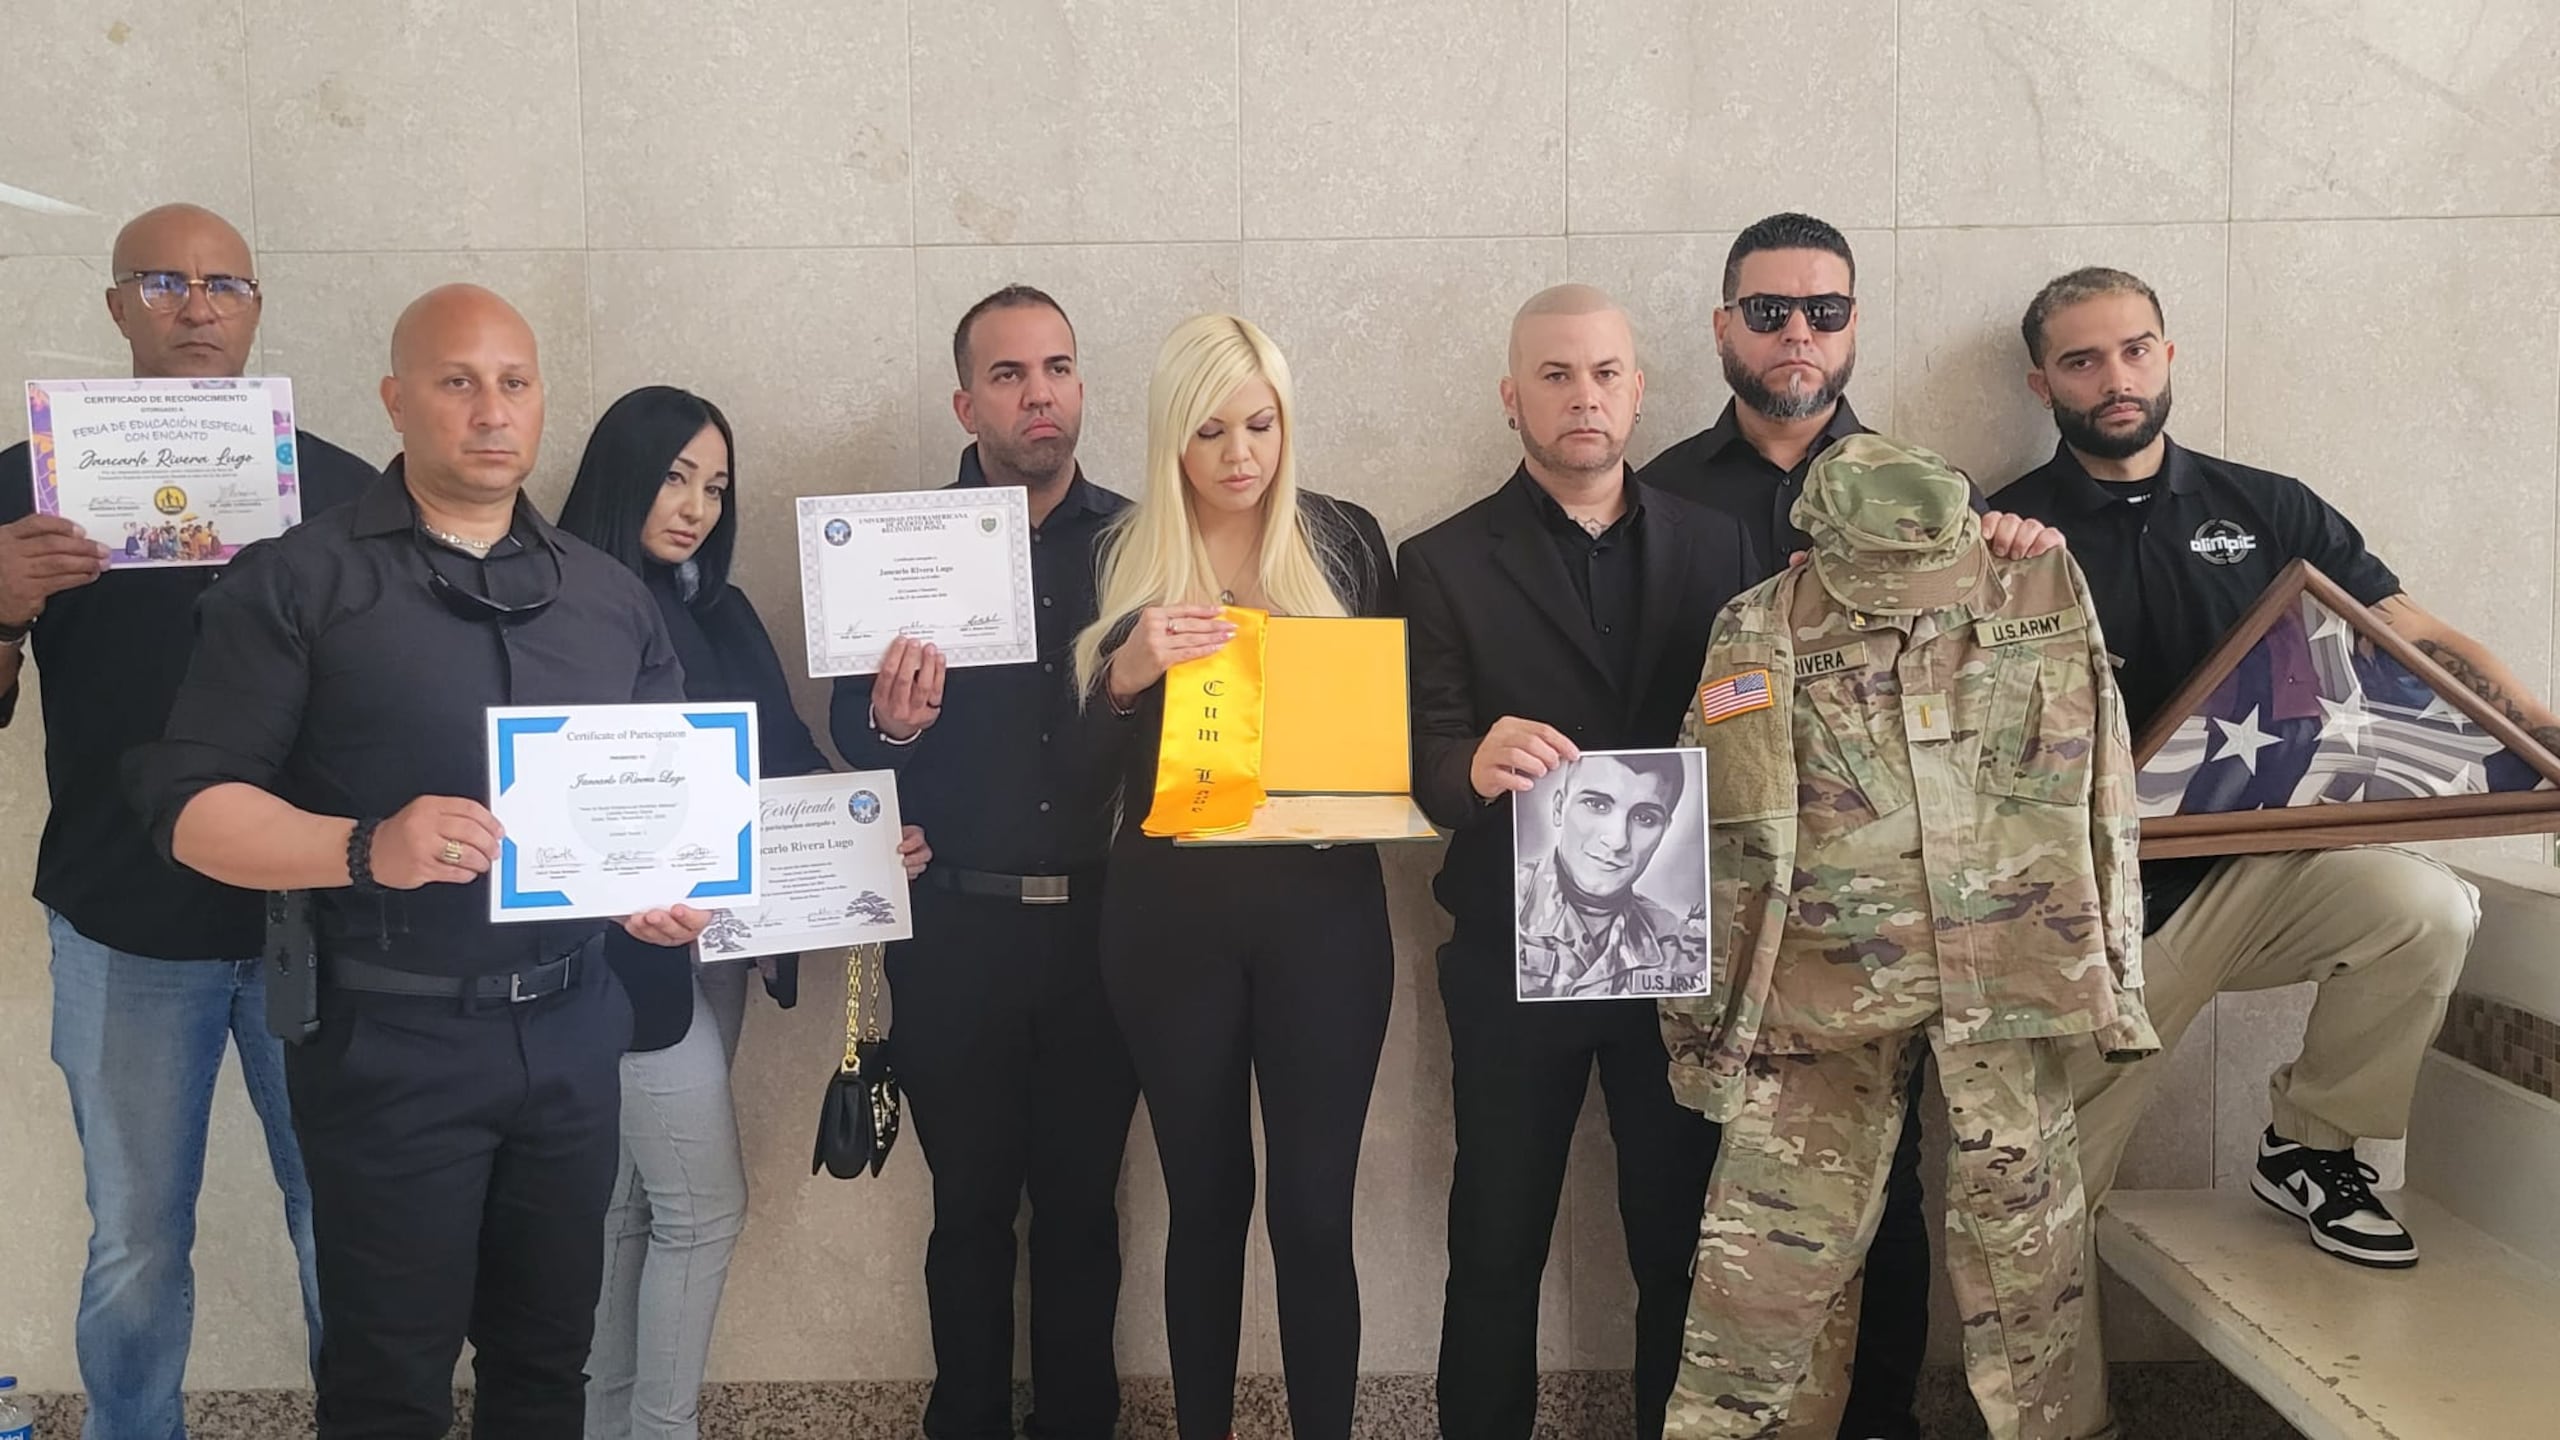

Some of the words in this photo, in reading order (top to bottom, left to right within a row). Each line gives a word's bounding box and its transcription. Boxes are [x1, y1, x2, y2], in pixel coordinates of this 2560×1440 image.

[84, 395, 148, 404] CERTIFICADO
[150, 395, 162, 404] DE
[165, 394, 248, 403] RECONOCIMIENTO
[72, 424, 109, 439] FERIA
[111, 421, 127, 432] DE
[129, 416, 198, 431] EDUCACIÓN
[201, 419, 256, 435] ESPECIAL
[125, 431, 150, 443] CON
[153, 429, 209, 441] ENCANTO
[79, 449, 149, 470] Jancarlo
[156, 447, 210, 468] Rivera
[215, 446, 255, 469] Lugo
[566, 730, 615, 742] Certificate
[617, 730, 627, 740] of
[630, 729, 687, 742] Participation
[760, 797, 836, 823] Certificado
[760, 843, 789, 856] carlo
[791, 841, 825, 853] Rivera
[828, 838, 854, 850] Lugo
